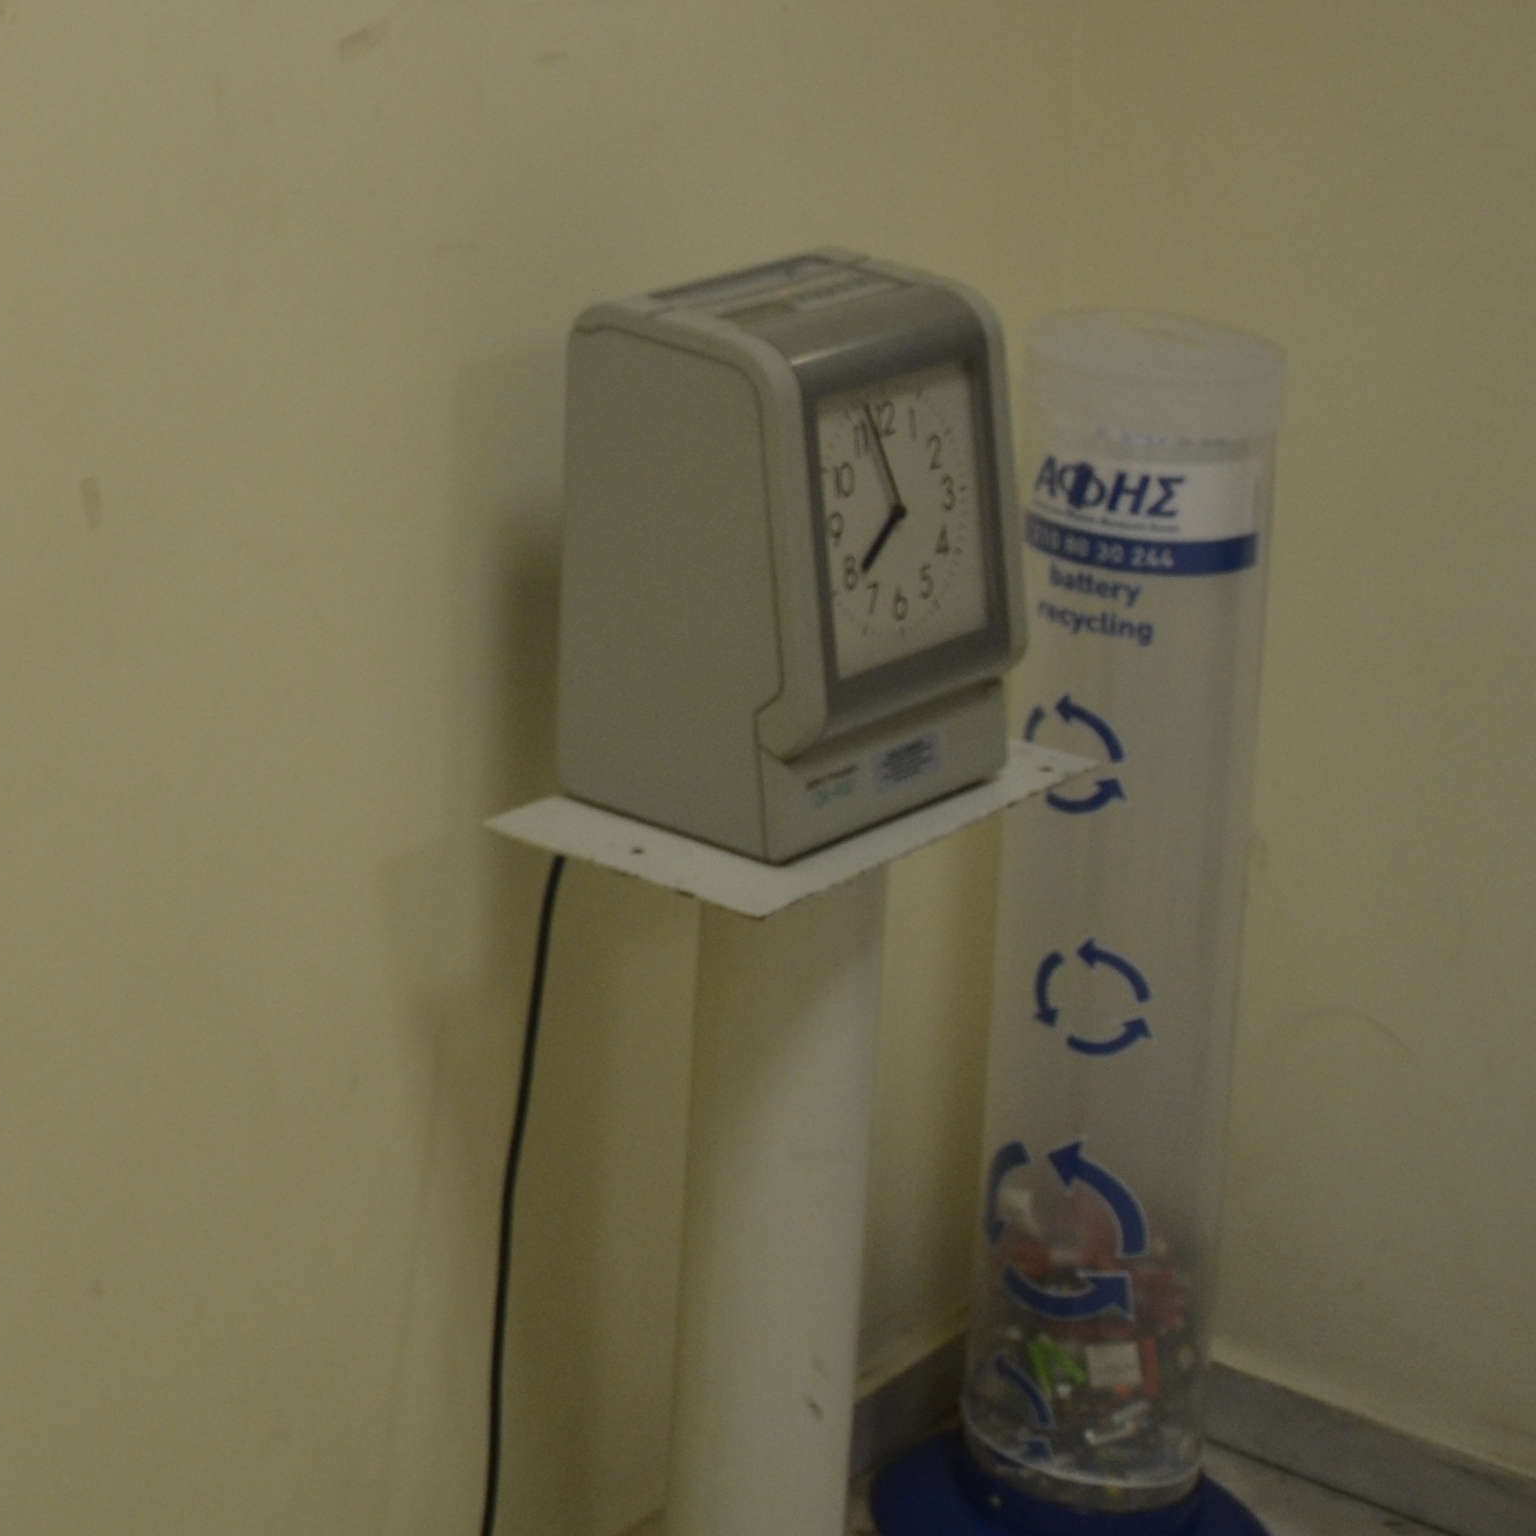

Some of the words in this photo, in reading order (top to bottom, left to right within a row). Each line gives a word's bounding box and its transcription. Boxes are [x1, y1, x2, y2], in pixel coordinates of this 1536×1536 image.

[928, 435, 942, 470] 2
[833, 462, 856, 497] 10
[940, 476, 956, 510] 3
[1034, 455, 1185, 518] ΑΦΗΣ
[831, 512, 844, 547] 9
[935, 526, 949, 555] 4
[843, 555, 858, 590] 8
[920, 564, 934, 599] 5
[1049, 560, 1142, 608] battery
[867, 581, 880, 614] 7
[892, 586, 909, 621] 6
[1038, 599, 1155, 648] recycling
